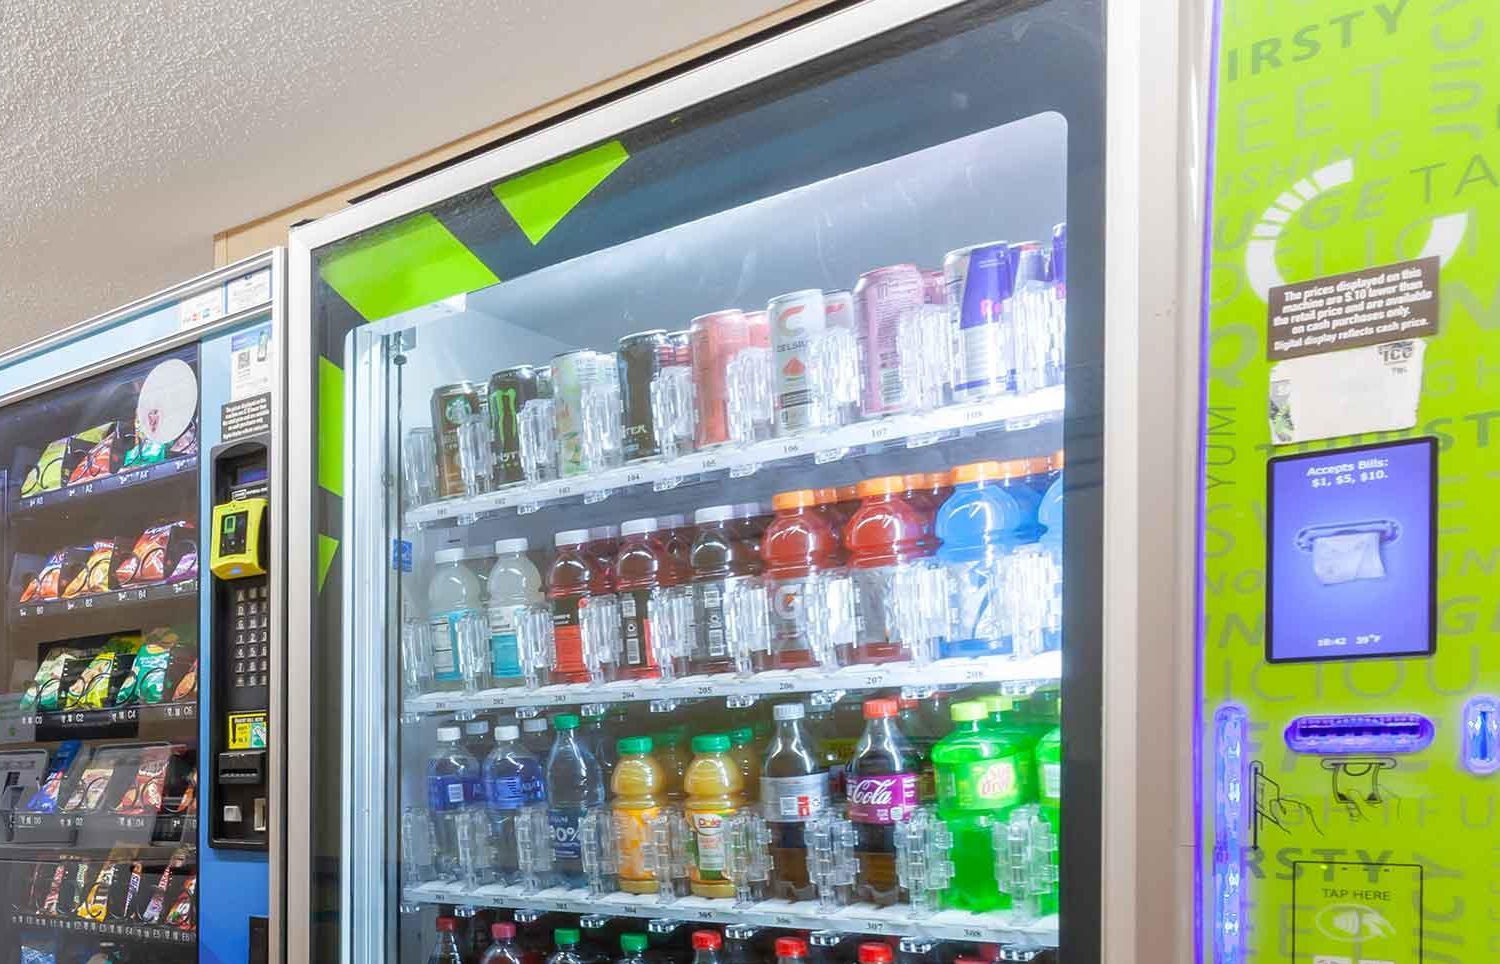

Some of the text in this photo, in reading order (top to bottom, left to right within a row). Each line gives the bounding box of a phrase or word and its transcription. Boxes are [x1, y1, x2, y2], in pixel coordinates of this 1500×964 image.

[1306, 458, 1389, 477] Accepts Bills:
[852, 779, 898, 805] Cola
[1323, 887, 1391, 902] TAP HERE
